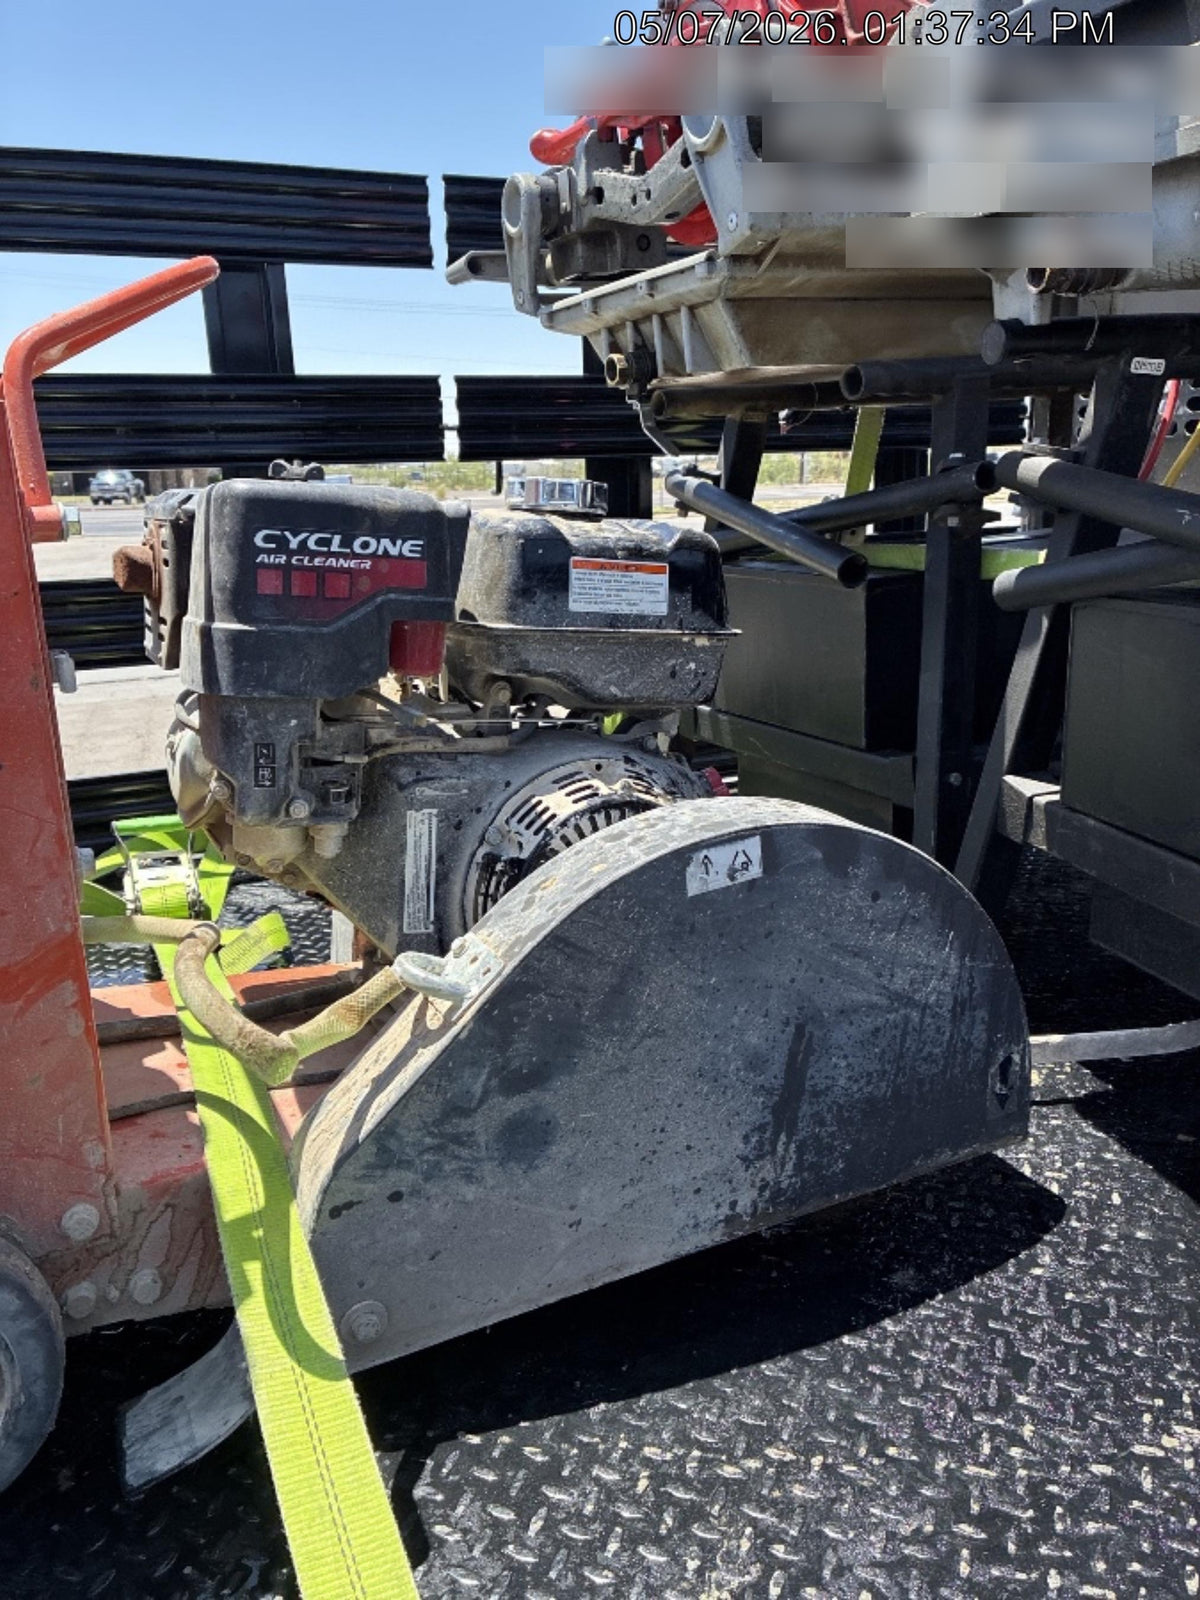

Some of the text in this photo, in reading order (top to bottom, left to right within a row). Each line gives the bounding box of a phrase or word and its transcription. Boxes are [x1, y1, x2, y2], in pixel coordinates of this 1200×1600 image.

[253, 529, 424, 558] CYCLONE
[255, 553, 372, 570] AIR CLEANER
